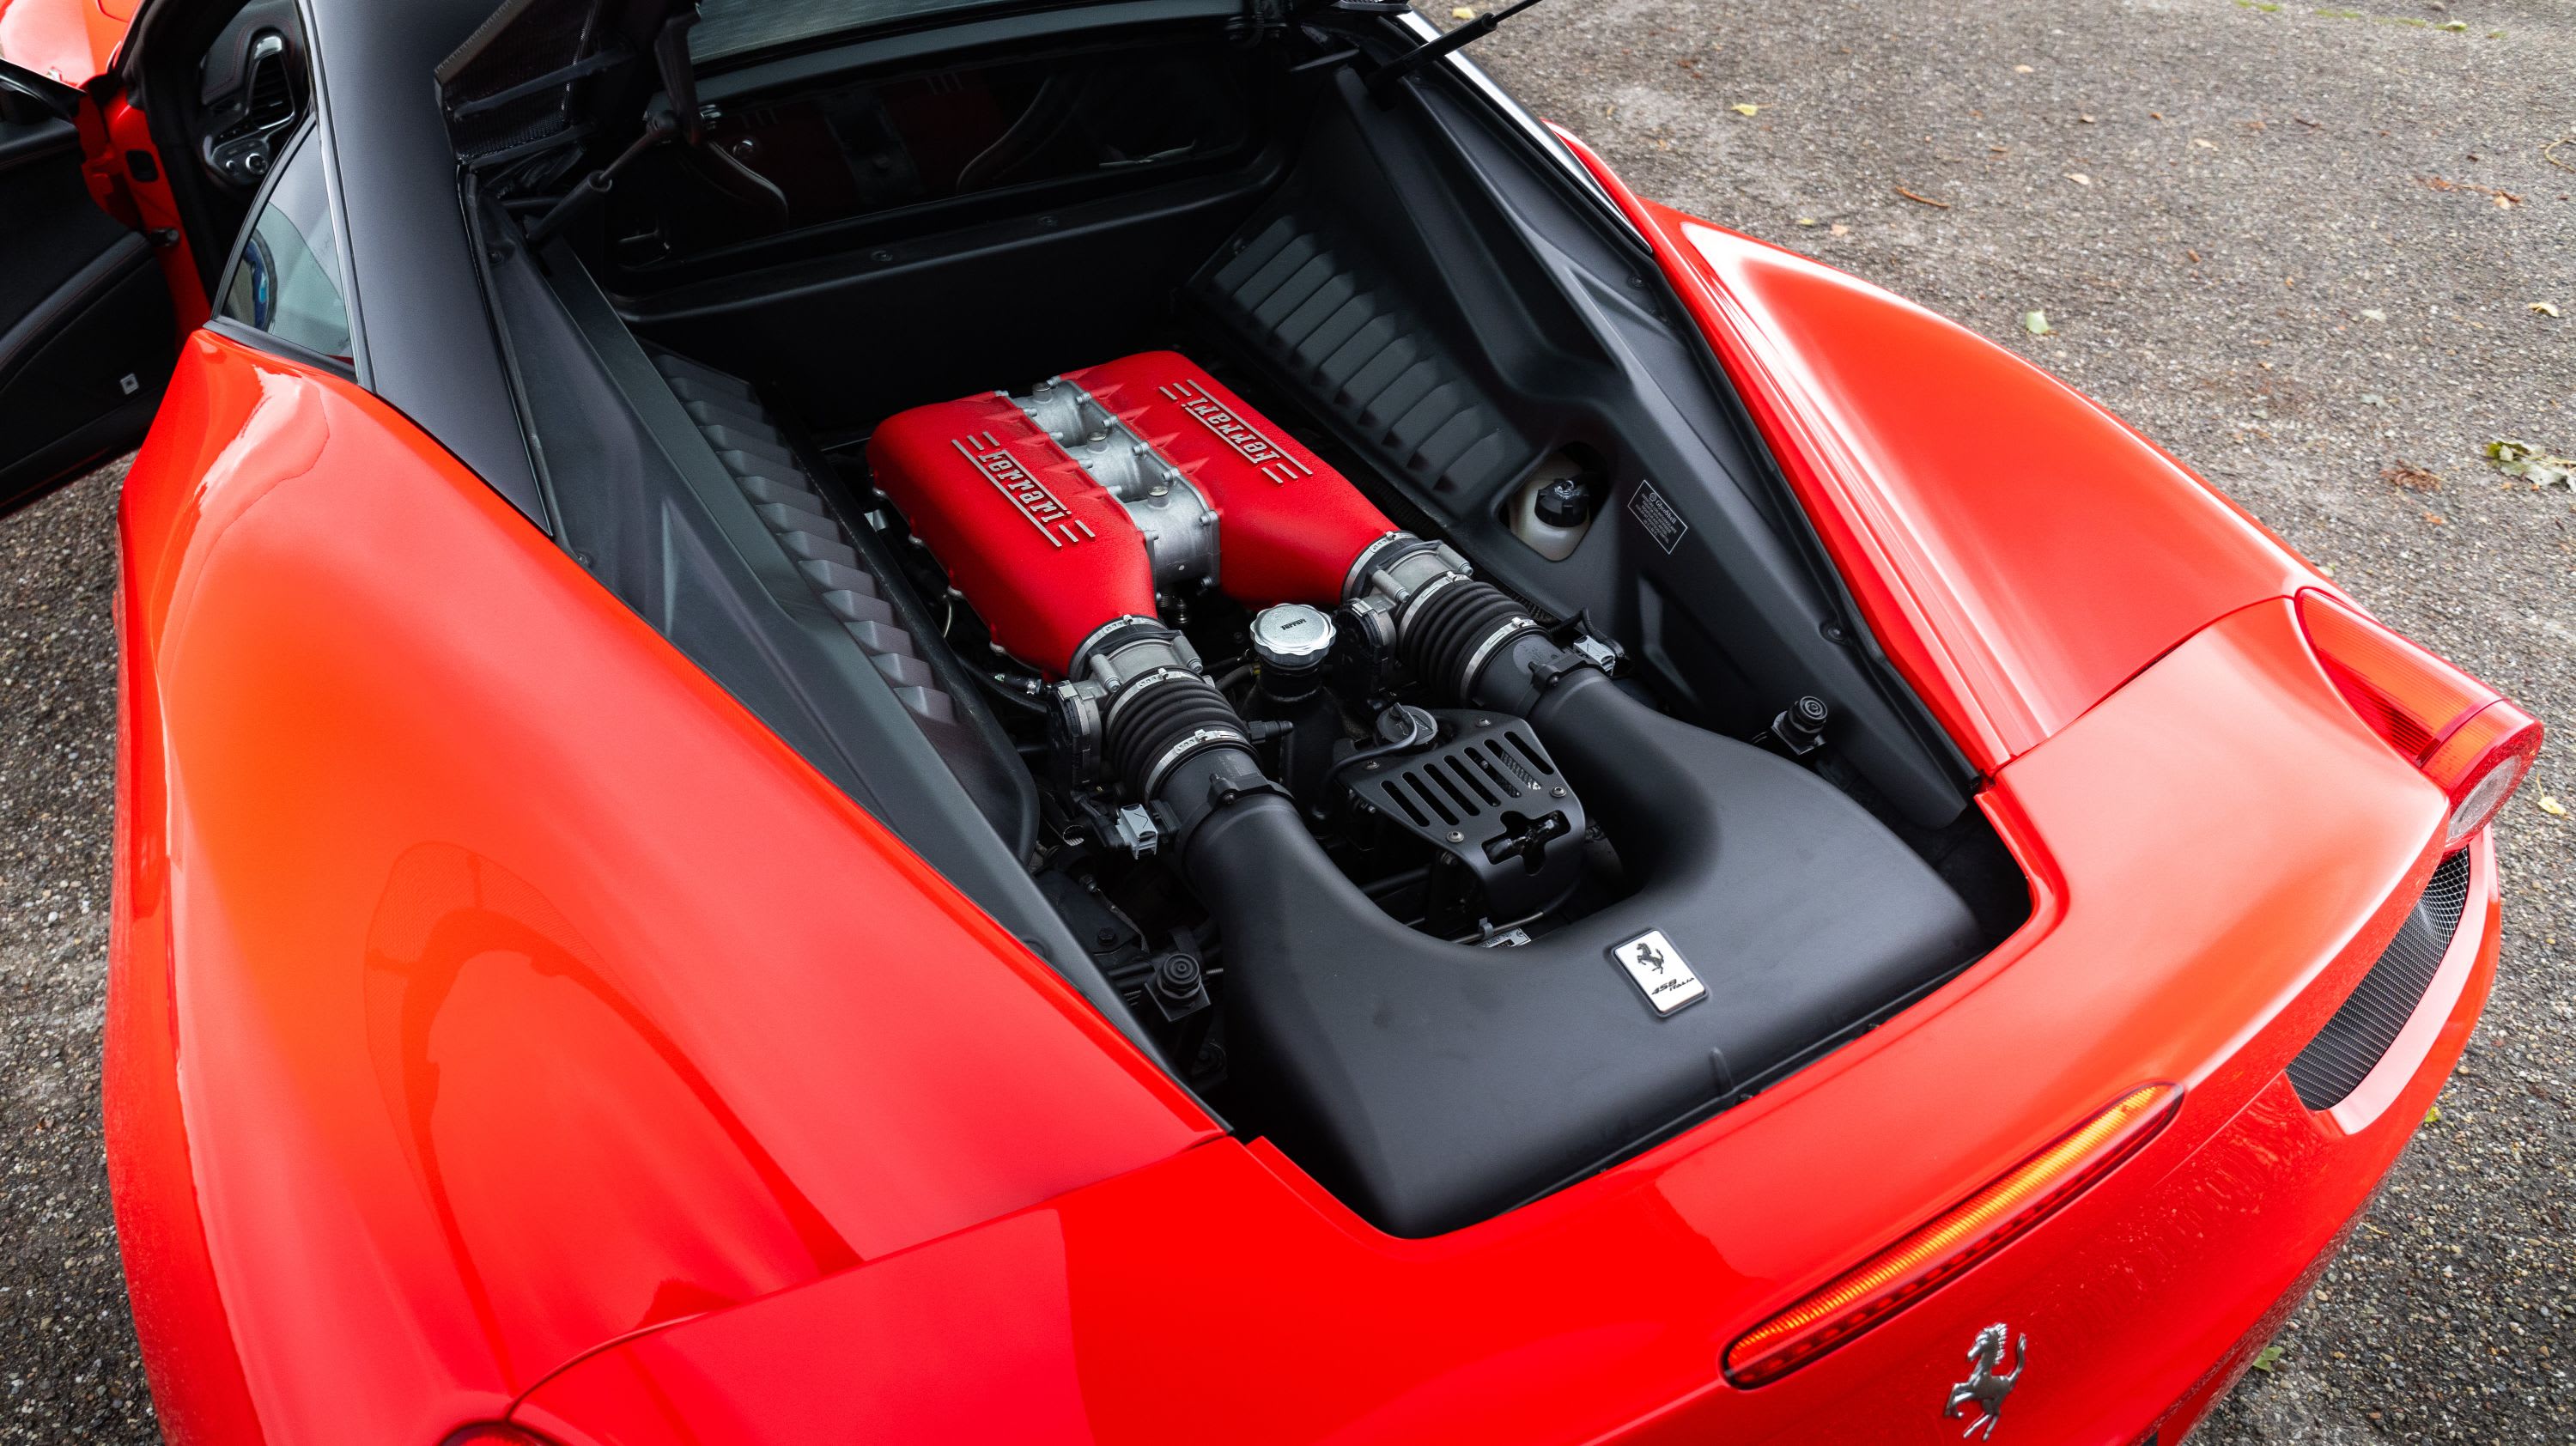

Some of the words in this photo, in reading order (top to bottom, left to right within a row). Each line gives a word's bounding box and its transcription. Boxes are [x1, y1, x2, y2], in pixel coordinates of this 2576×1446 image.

[1182, 397, 1280, 465] Ferrari
[977, 450, 1072, 523] Ferrari
[1656, 500, 1677, 524] GlycoShell
[1280, 618, 1307, 630] Ferrari
[1651, 978, 1677, 995] 458
